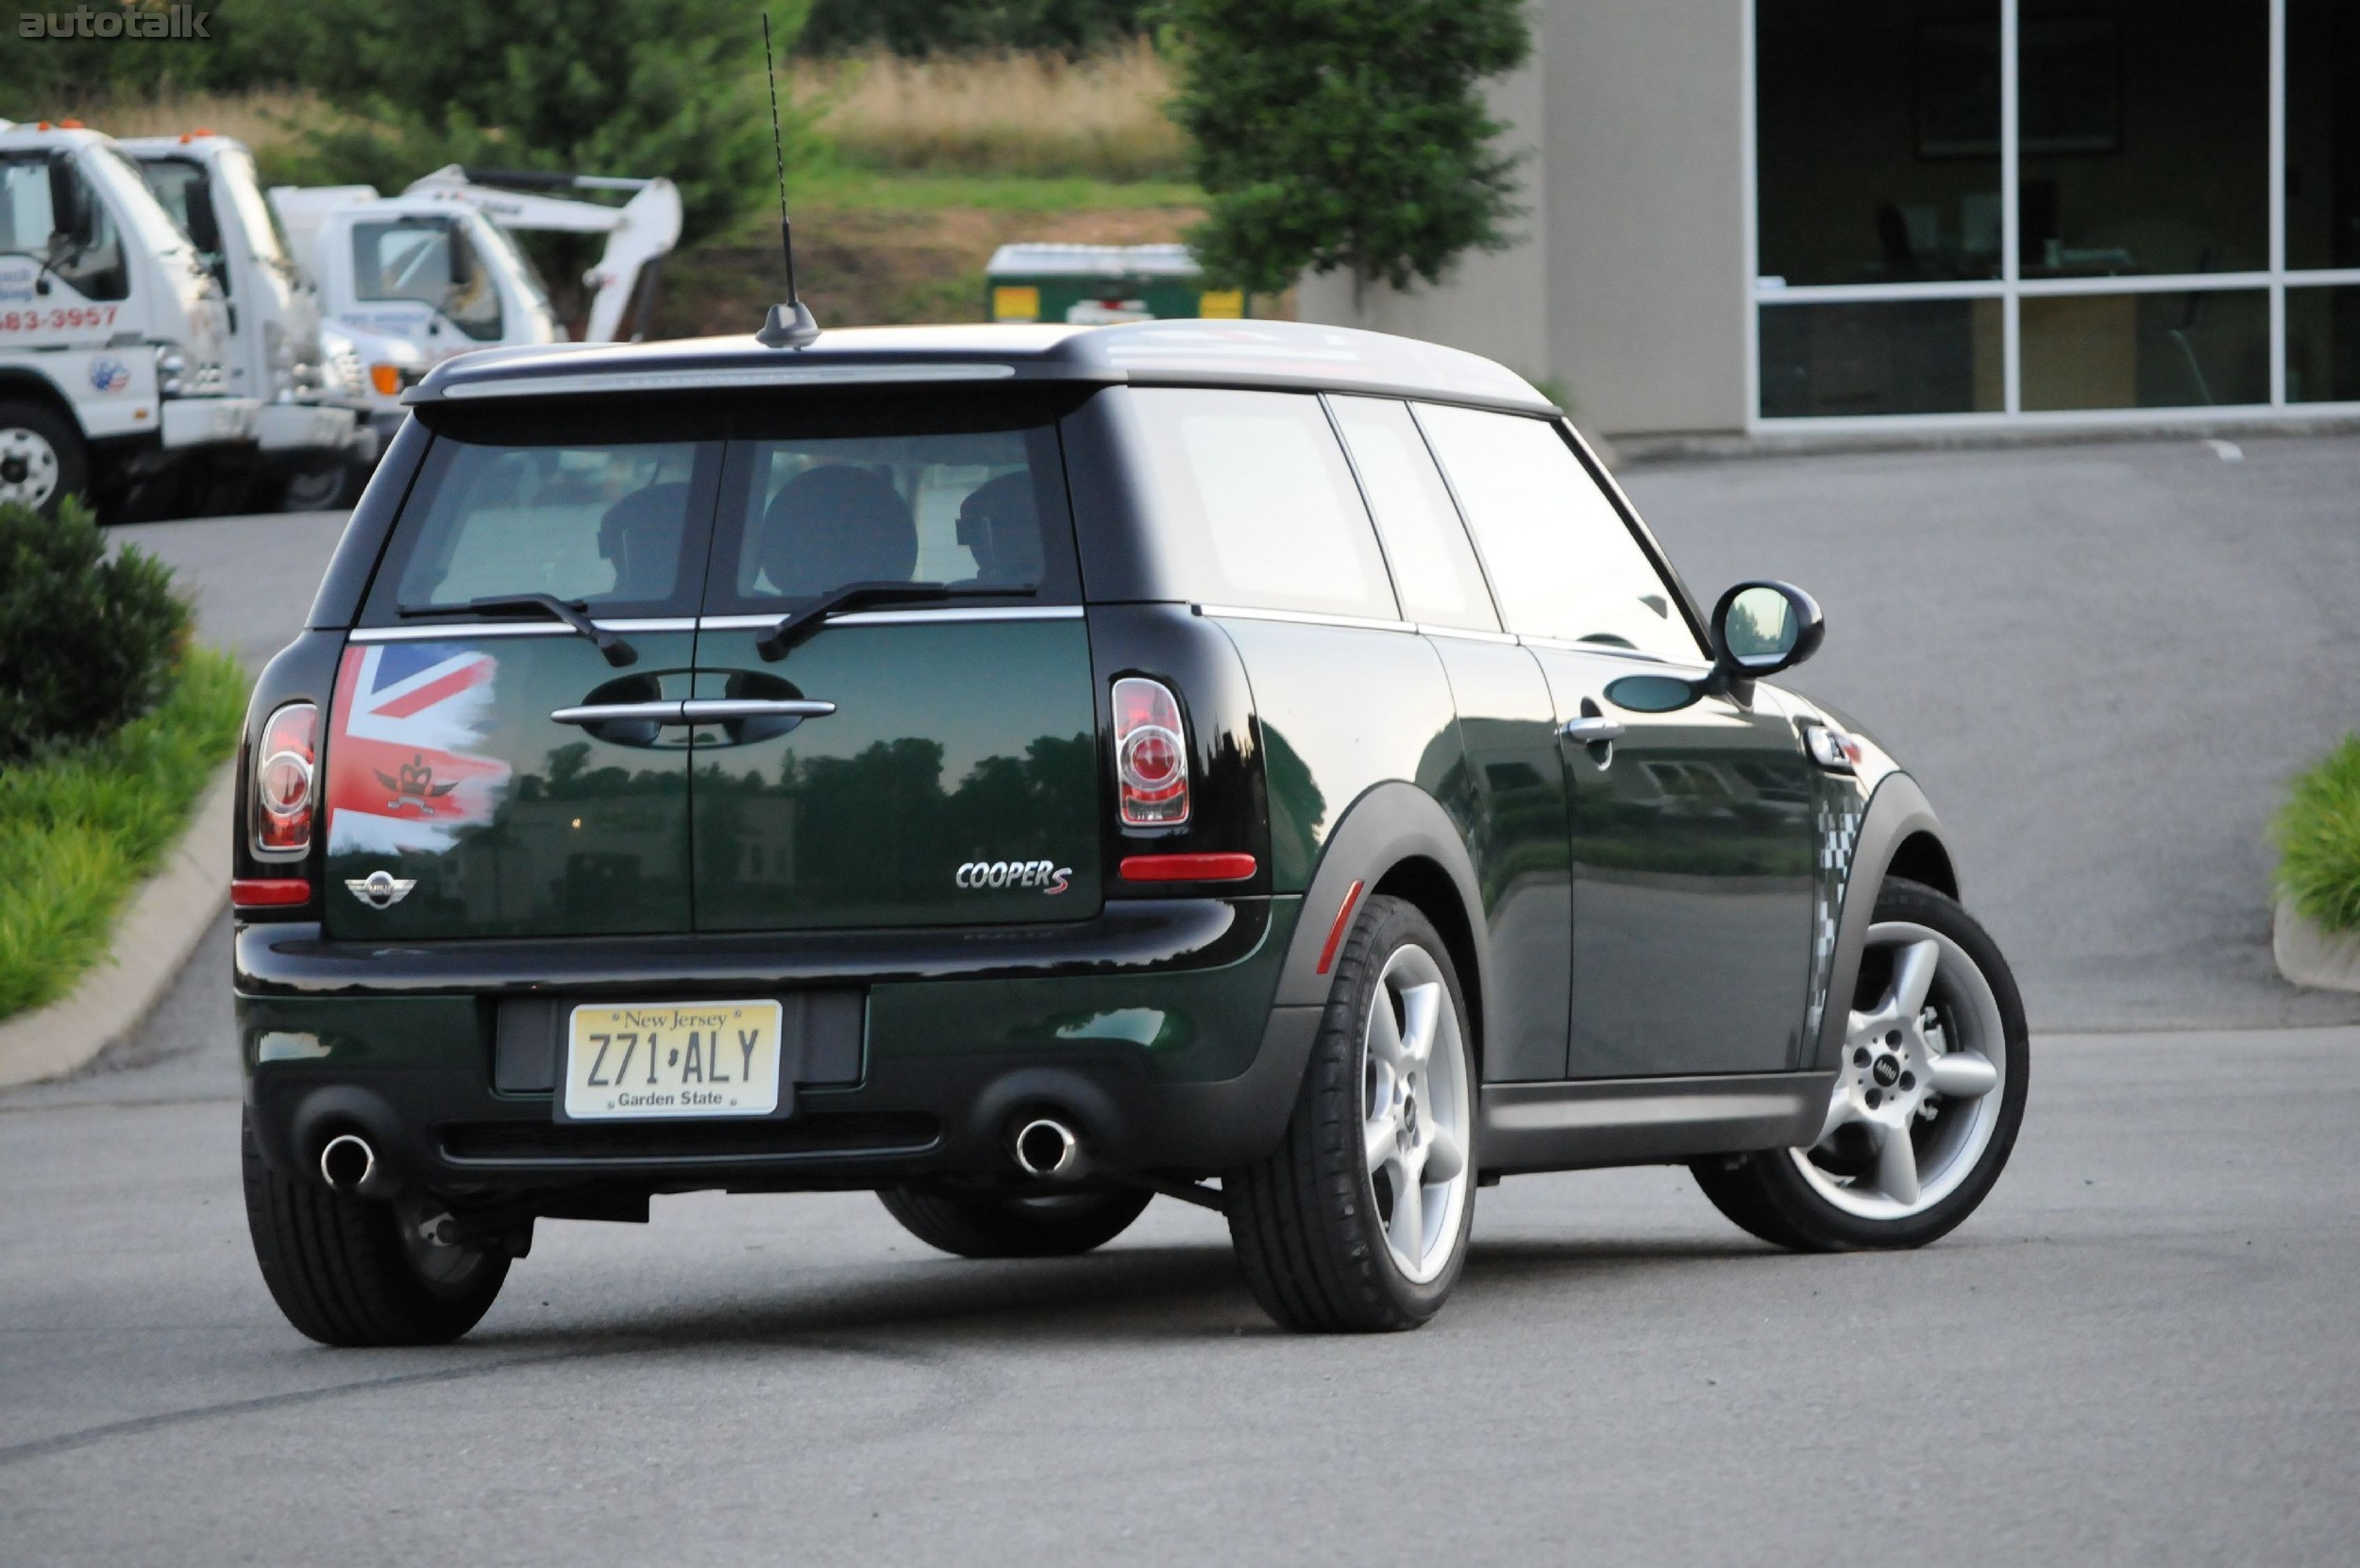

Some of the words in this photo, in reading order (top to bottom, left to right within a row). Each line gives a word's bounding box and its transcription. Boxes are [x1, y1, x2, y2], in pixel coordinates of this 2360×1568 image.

[0, 305, 118, 330] 83-3957
[624, 1011, 667, 1028] New
[669, 1010, 727, 1031] Jersey
[1877, 1059, 1897, 1081] MINI
[618, 1091, 675, 1106] Garden
[681, 1090, 723, 1105] State
